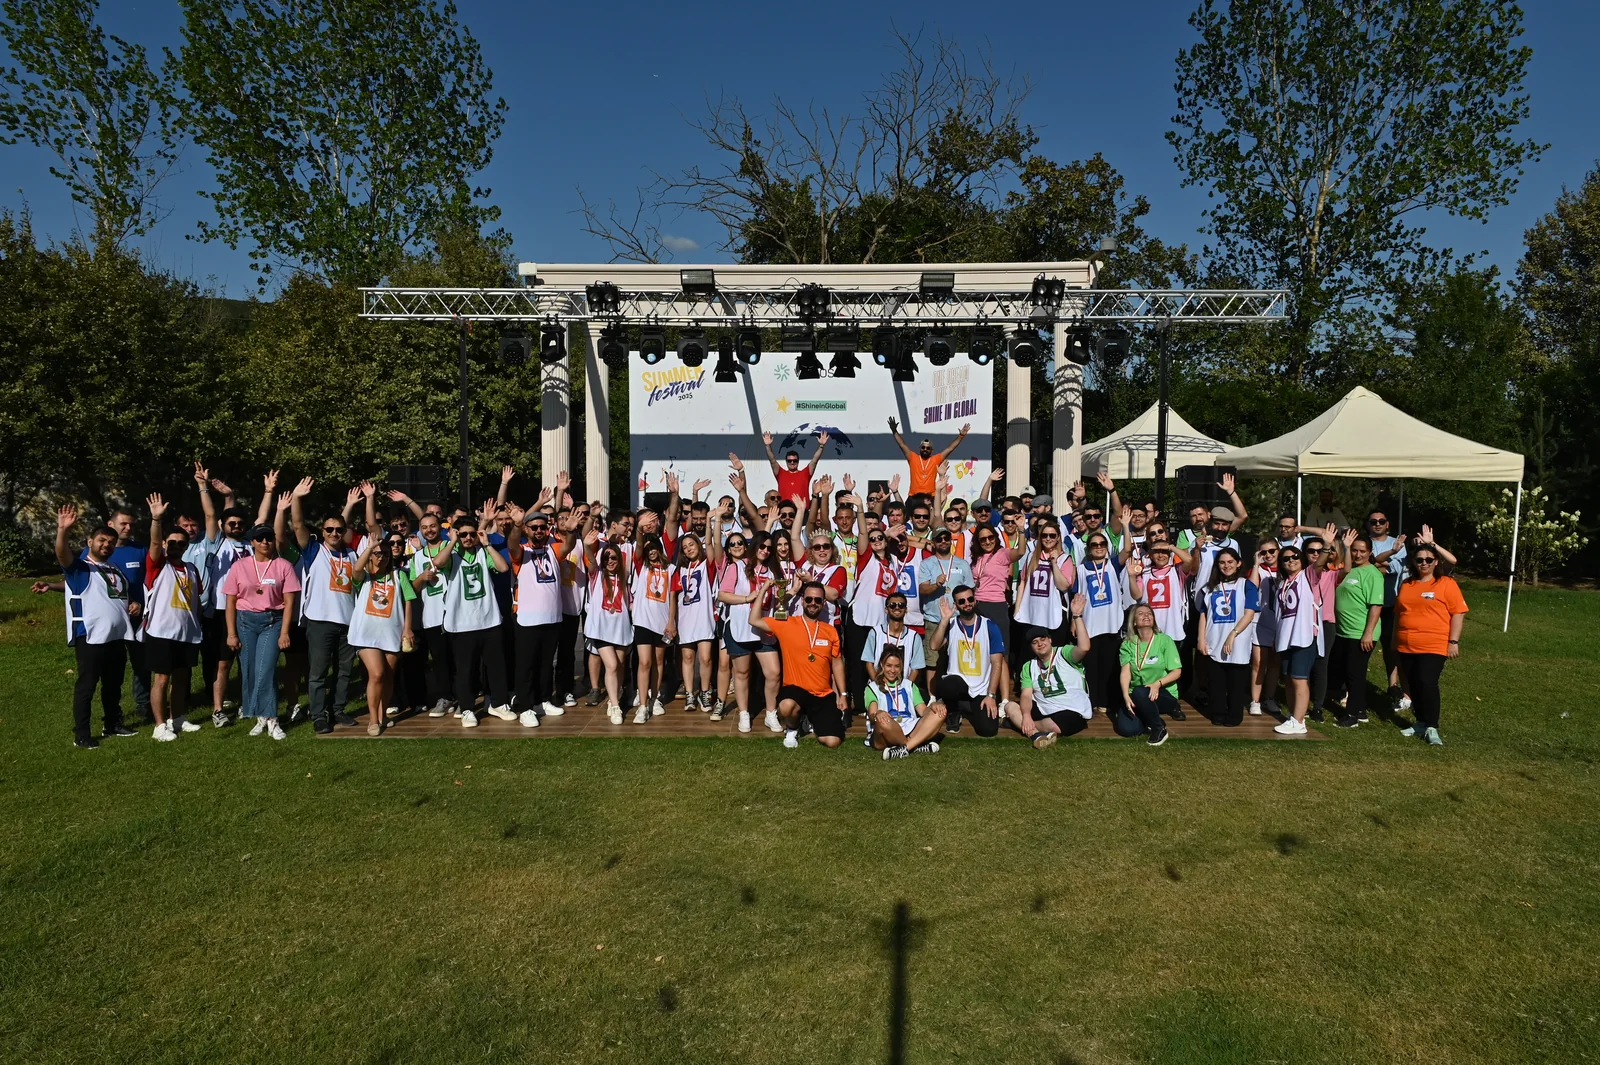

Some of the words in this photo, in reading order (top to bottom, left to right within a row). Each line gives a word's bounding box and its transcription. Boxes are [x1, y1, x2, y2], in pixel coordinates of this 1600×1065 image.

[641, 365, 704, 392] SUMMER
[932, 369, 945, 388] ONE
[947, 365, 970, 386] DREAM
[647, 369, 706, 407] festival
[678, 392, 693, 401] 2025
[934, 385, 948, 404] ONE
[949, 382, 968, 402] TEAM
[923, 404, 943, 425] SHINE
[944, 402, 952, 420] IN
[953, 398, 977, 419] GLOBAL
[466, 573, 482, 594] 5
[1032, 569, 1049, 590] 12
[1091, 579, 1107, 601] 2
[1151, 582, 1165, 602] 2
[1215, 595, 1232, 617] 8
[962, 649, 976, 669] 4
